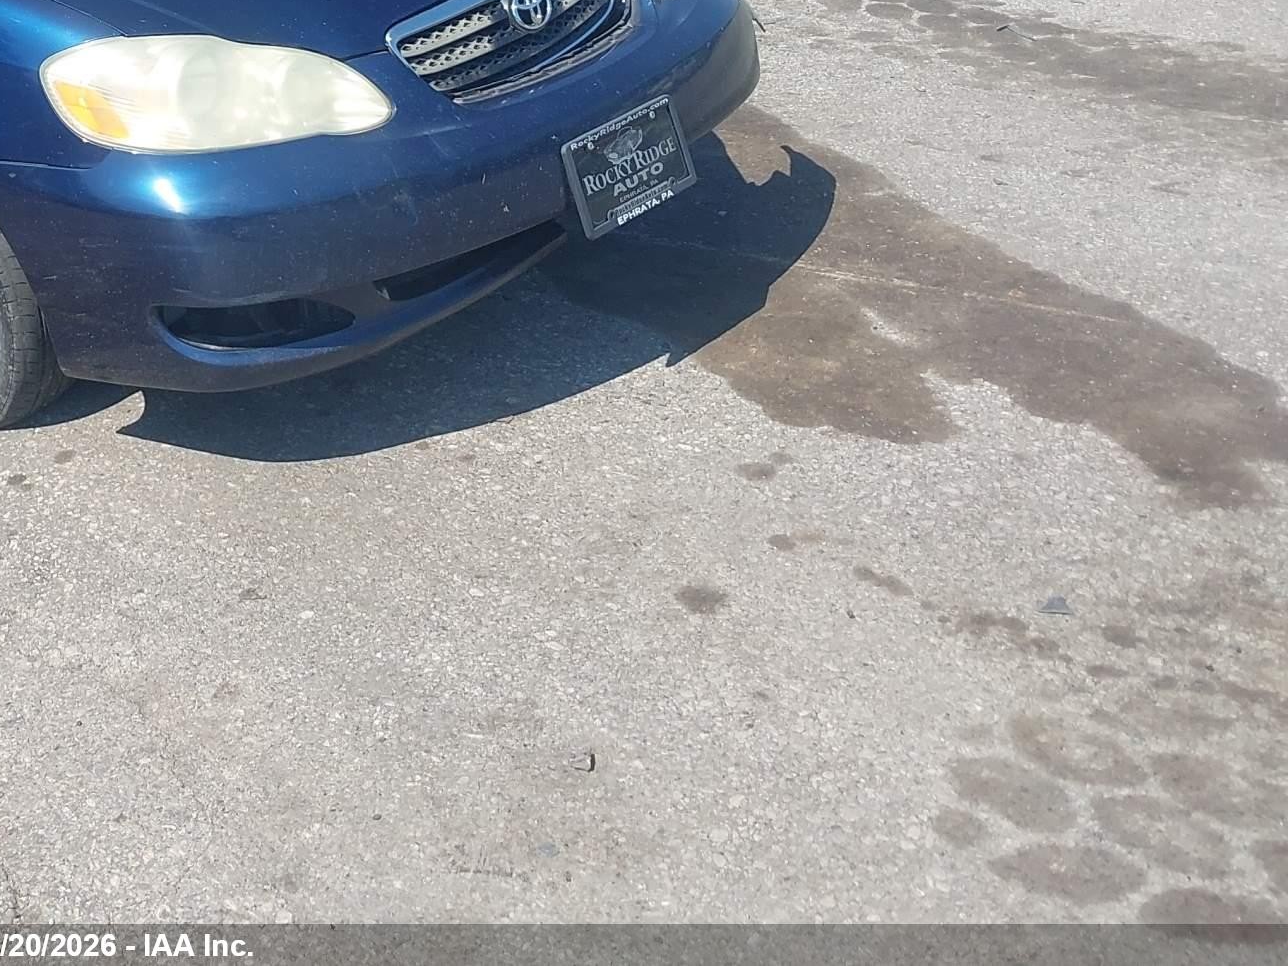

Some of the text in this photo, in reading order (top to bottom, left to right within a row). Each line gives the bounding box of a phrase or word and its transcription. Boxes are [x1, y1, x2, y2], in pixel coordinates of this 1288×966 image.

[570, 97, 669, 151] RockyRidgeAuto.com
[582, 137, 677, 196] ROCKY RIDGE
[613, 161, 664, 197] AUTO
[617, 189, 675, 226] EPHRATA, PA
